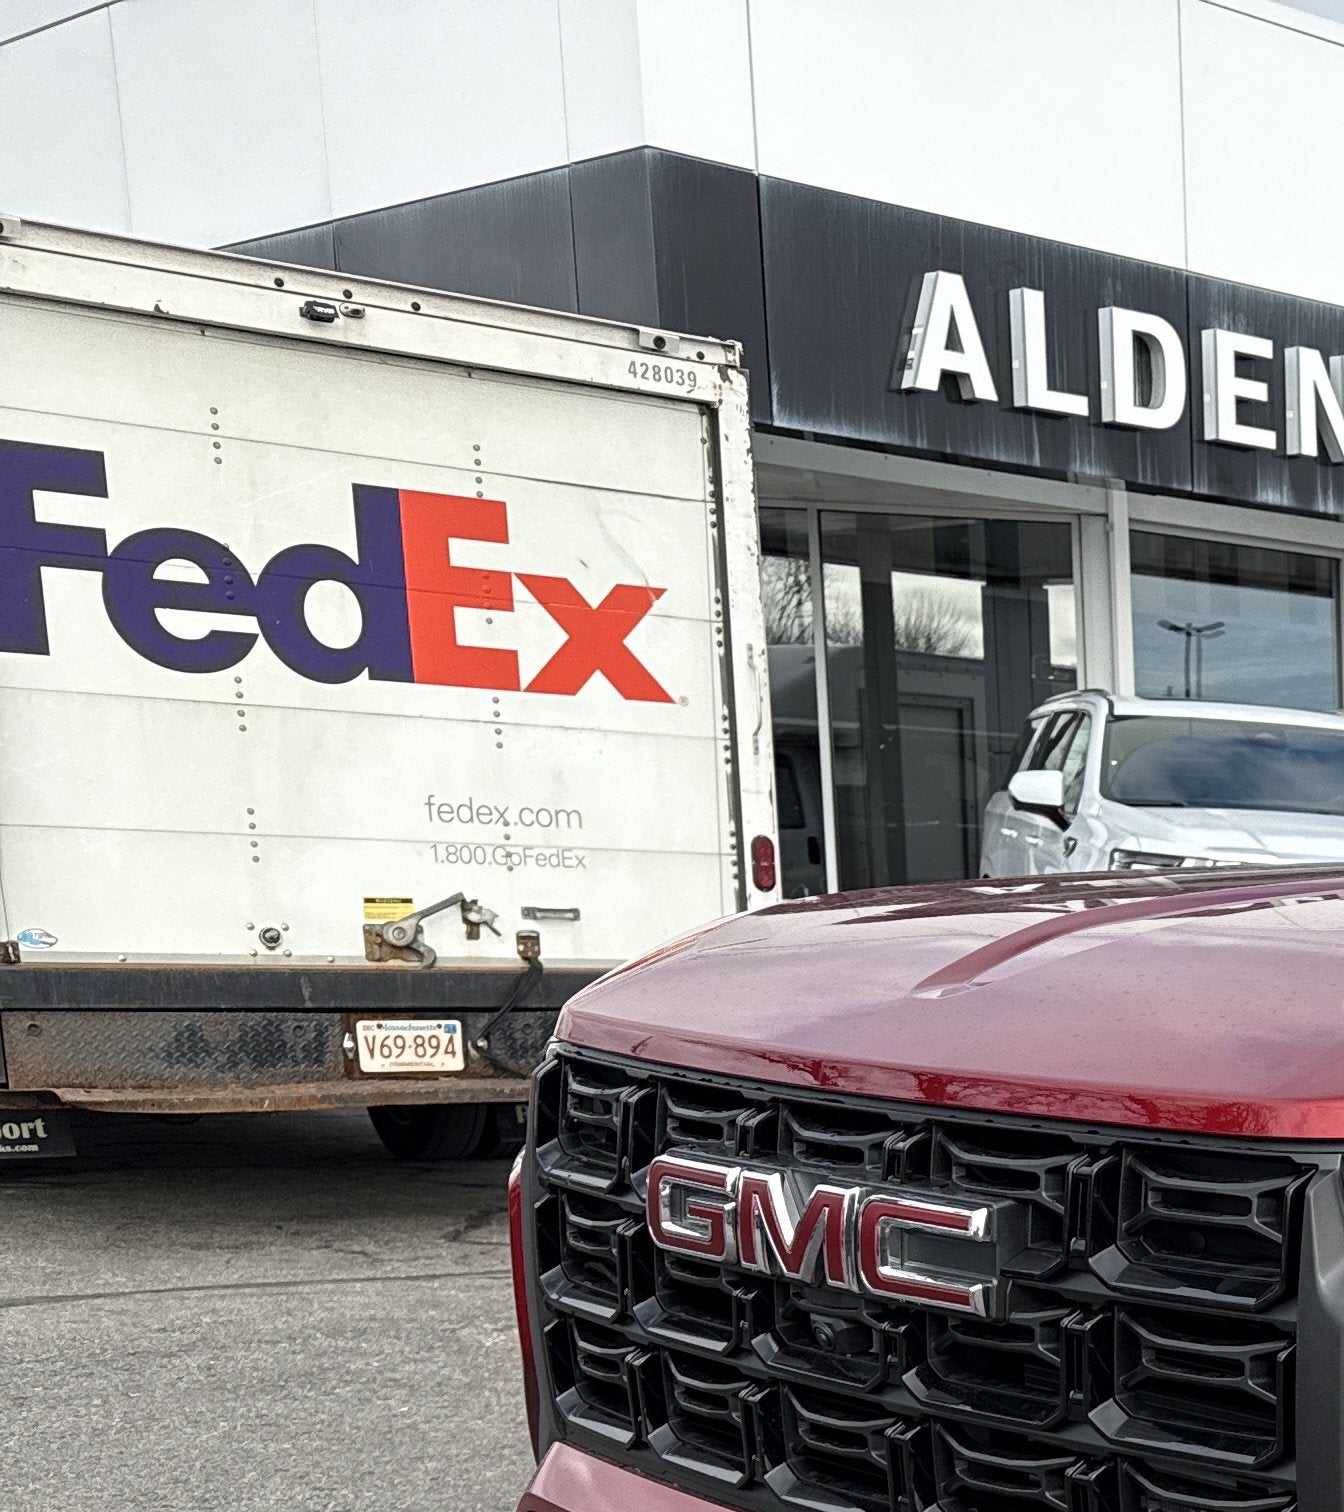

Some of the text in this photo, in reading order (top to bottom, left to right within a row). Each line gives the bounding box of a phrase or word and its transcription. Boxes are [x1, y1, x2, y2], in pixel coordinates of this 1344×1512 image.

[628, 361, 697, 388] 428039
[0, 438, 677, 705] FedEx
[424, 795, 583, 829] fedex.com
[430, 844, 587, 869] 1.800.GoFedEx
[0, 1117, 48, 1140] ort
[646, 1155, 992, 1317] GMC
